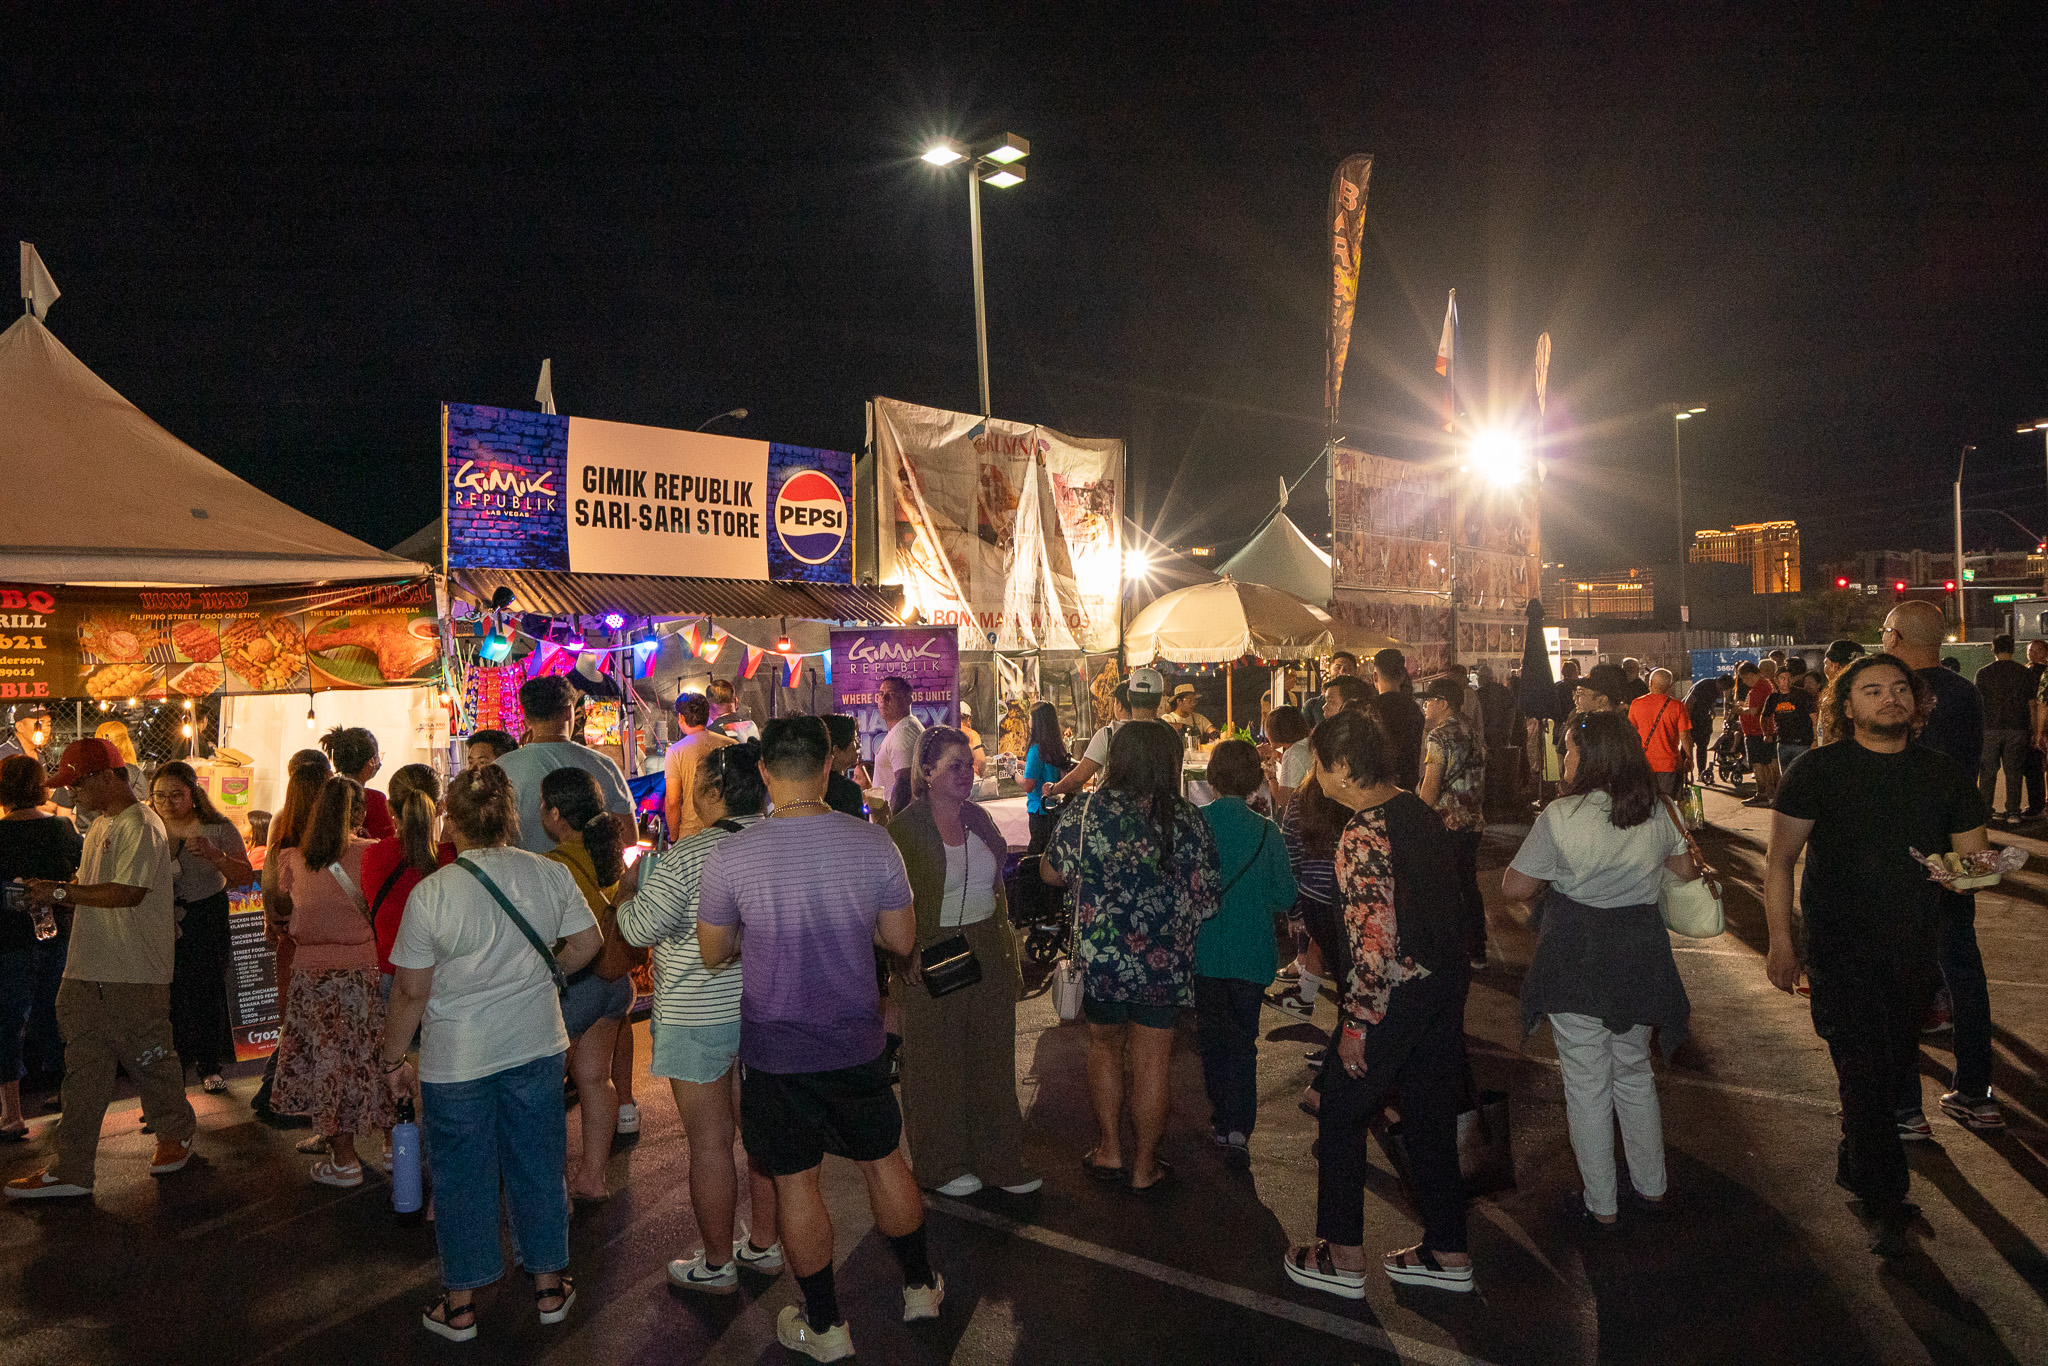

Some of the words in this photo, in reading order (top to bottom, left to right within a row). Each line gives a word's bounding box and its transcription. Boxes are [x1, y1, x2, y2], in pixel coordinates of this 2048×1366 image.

[582, 465, 647, 498] GIMIK
[654, 472, 753, 507] REPUBLIK
[456, 492, 555, 512] REPUBLIK
[575, 499, 691, 534] SARI-SARI
[697, 509, 760, 539] STORE
[780, 505, 843, 529] PEPSI
[850, 661, 940, 674] REPUBLIK
[842, 693, 872, 705] WHERE
[925, 691, 952, 702] UNITE
[239, 995, 264, 1003] ASSORTED
[240, 1001, 260, 1009] BANANA
